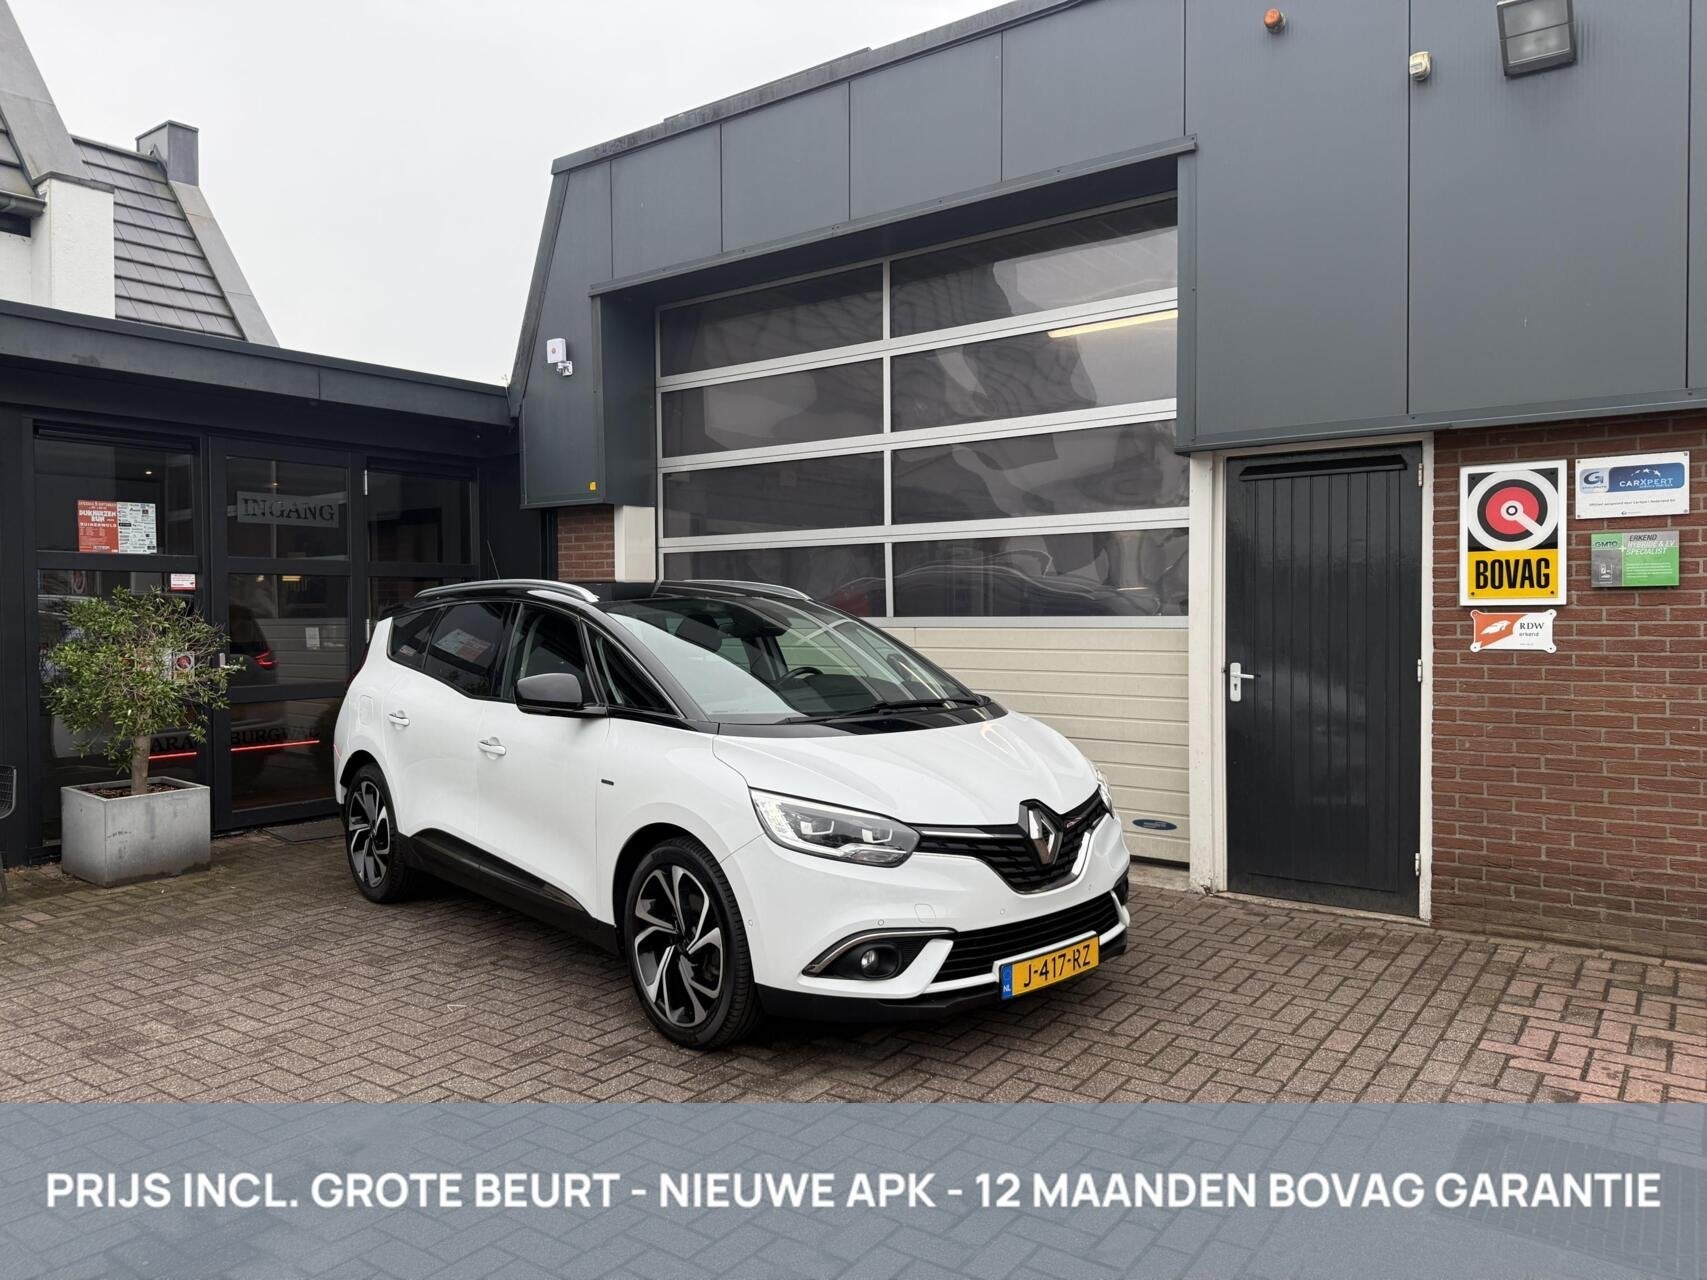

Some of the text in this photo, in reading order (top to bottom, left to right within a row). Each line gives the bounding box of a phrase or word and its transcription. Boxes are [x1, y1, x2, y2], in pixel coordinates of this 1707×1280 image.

[242, 498, 336, 521] INGANG
[1629, 534, 1658, 542] ERKEND
[1625, 547, 1667, 556] SPECIALIST
[1475, 558, 1550, 589] BOVAG
[1519, 622, 1545, 630] RDW
[1023, 944, 1090, 988] J-417-RZ
[1003, 984, 1011, 993] NL
